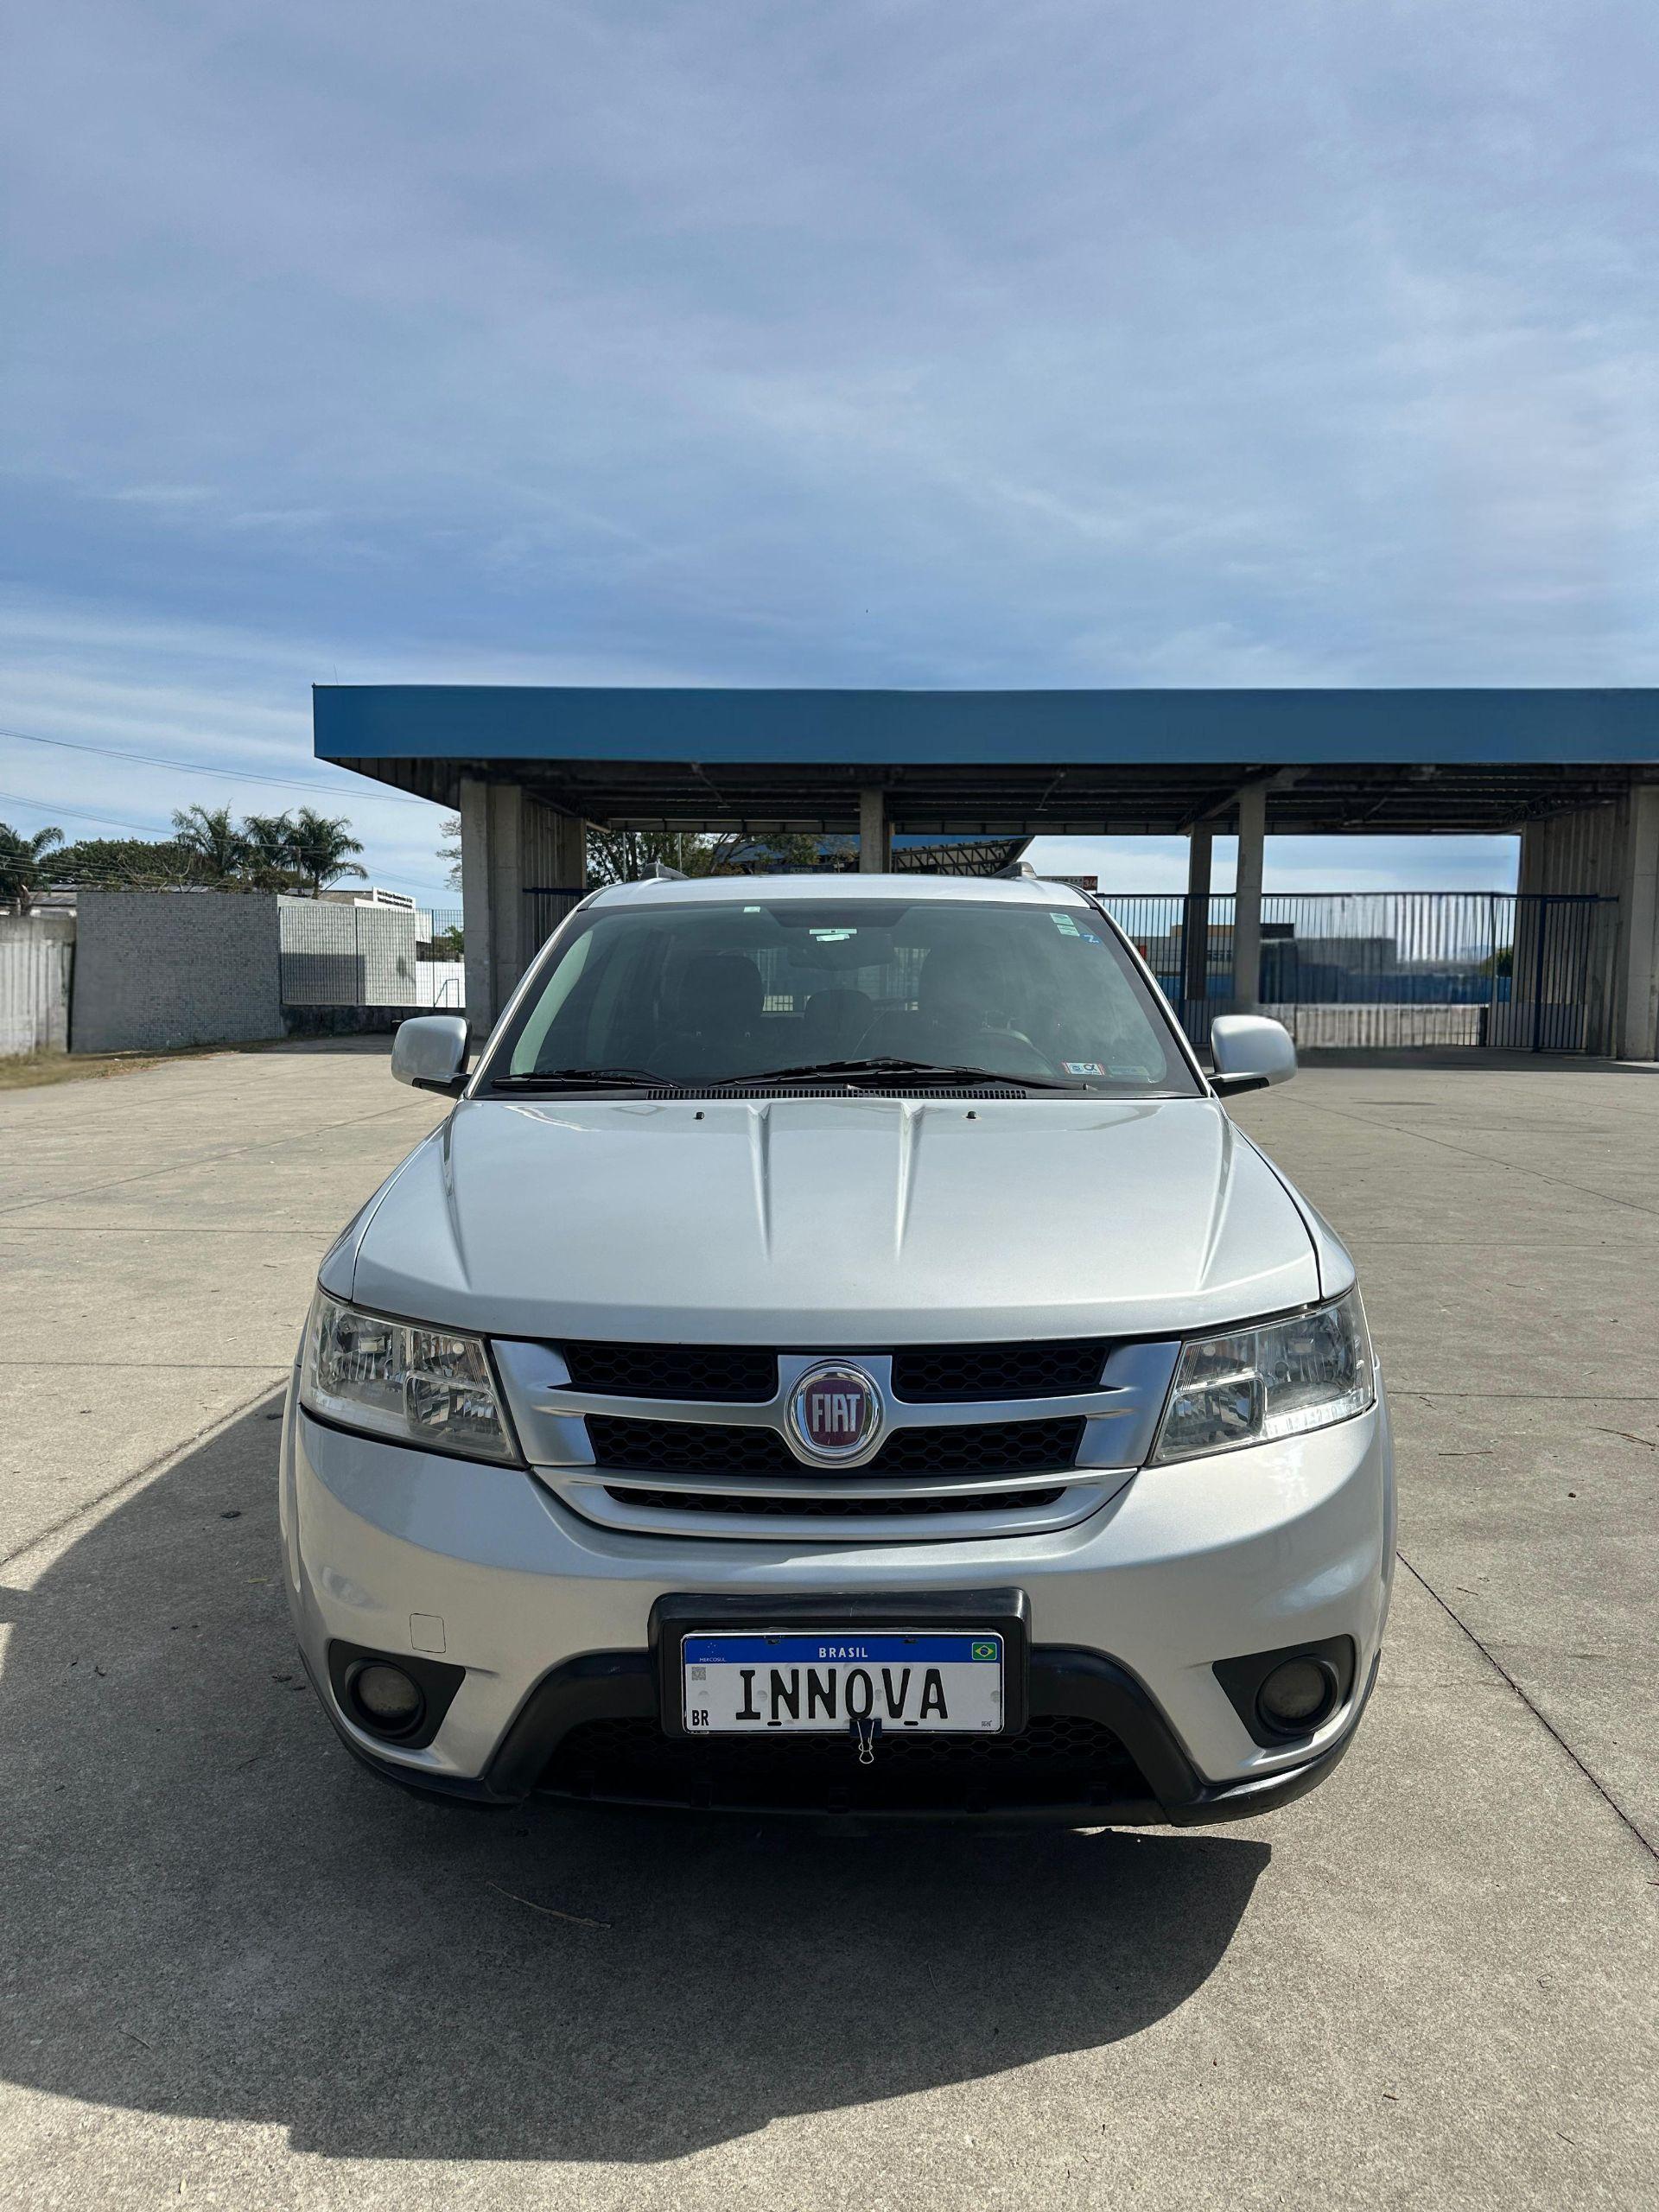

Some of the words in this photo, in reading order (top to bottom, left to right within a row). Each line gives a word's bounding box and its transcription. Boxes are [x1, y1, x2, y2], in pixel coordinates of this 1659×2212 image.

[812, 1393, 861, 1433] FIAT
[818, 1647, 868, 1658] BRASIL
[735, 1668, 949, 1720] INNOVA
[691, 1709, 709, 1726] BR
